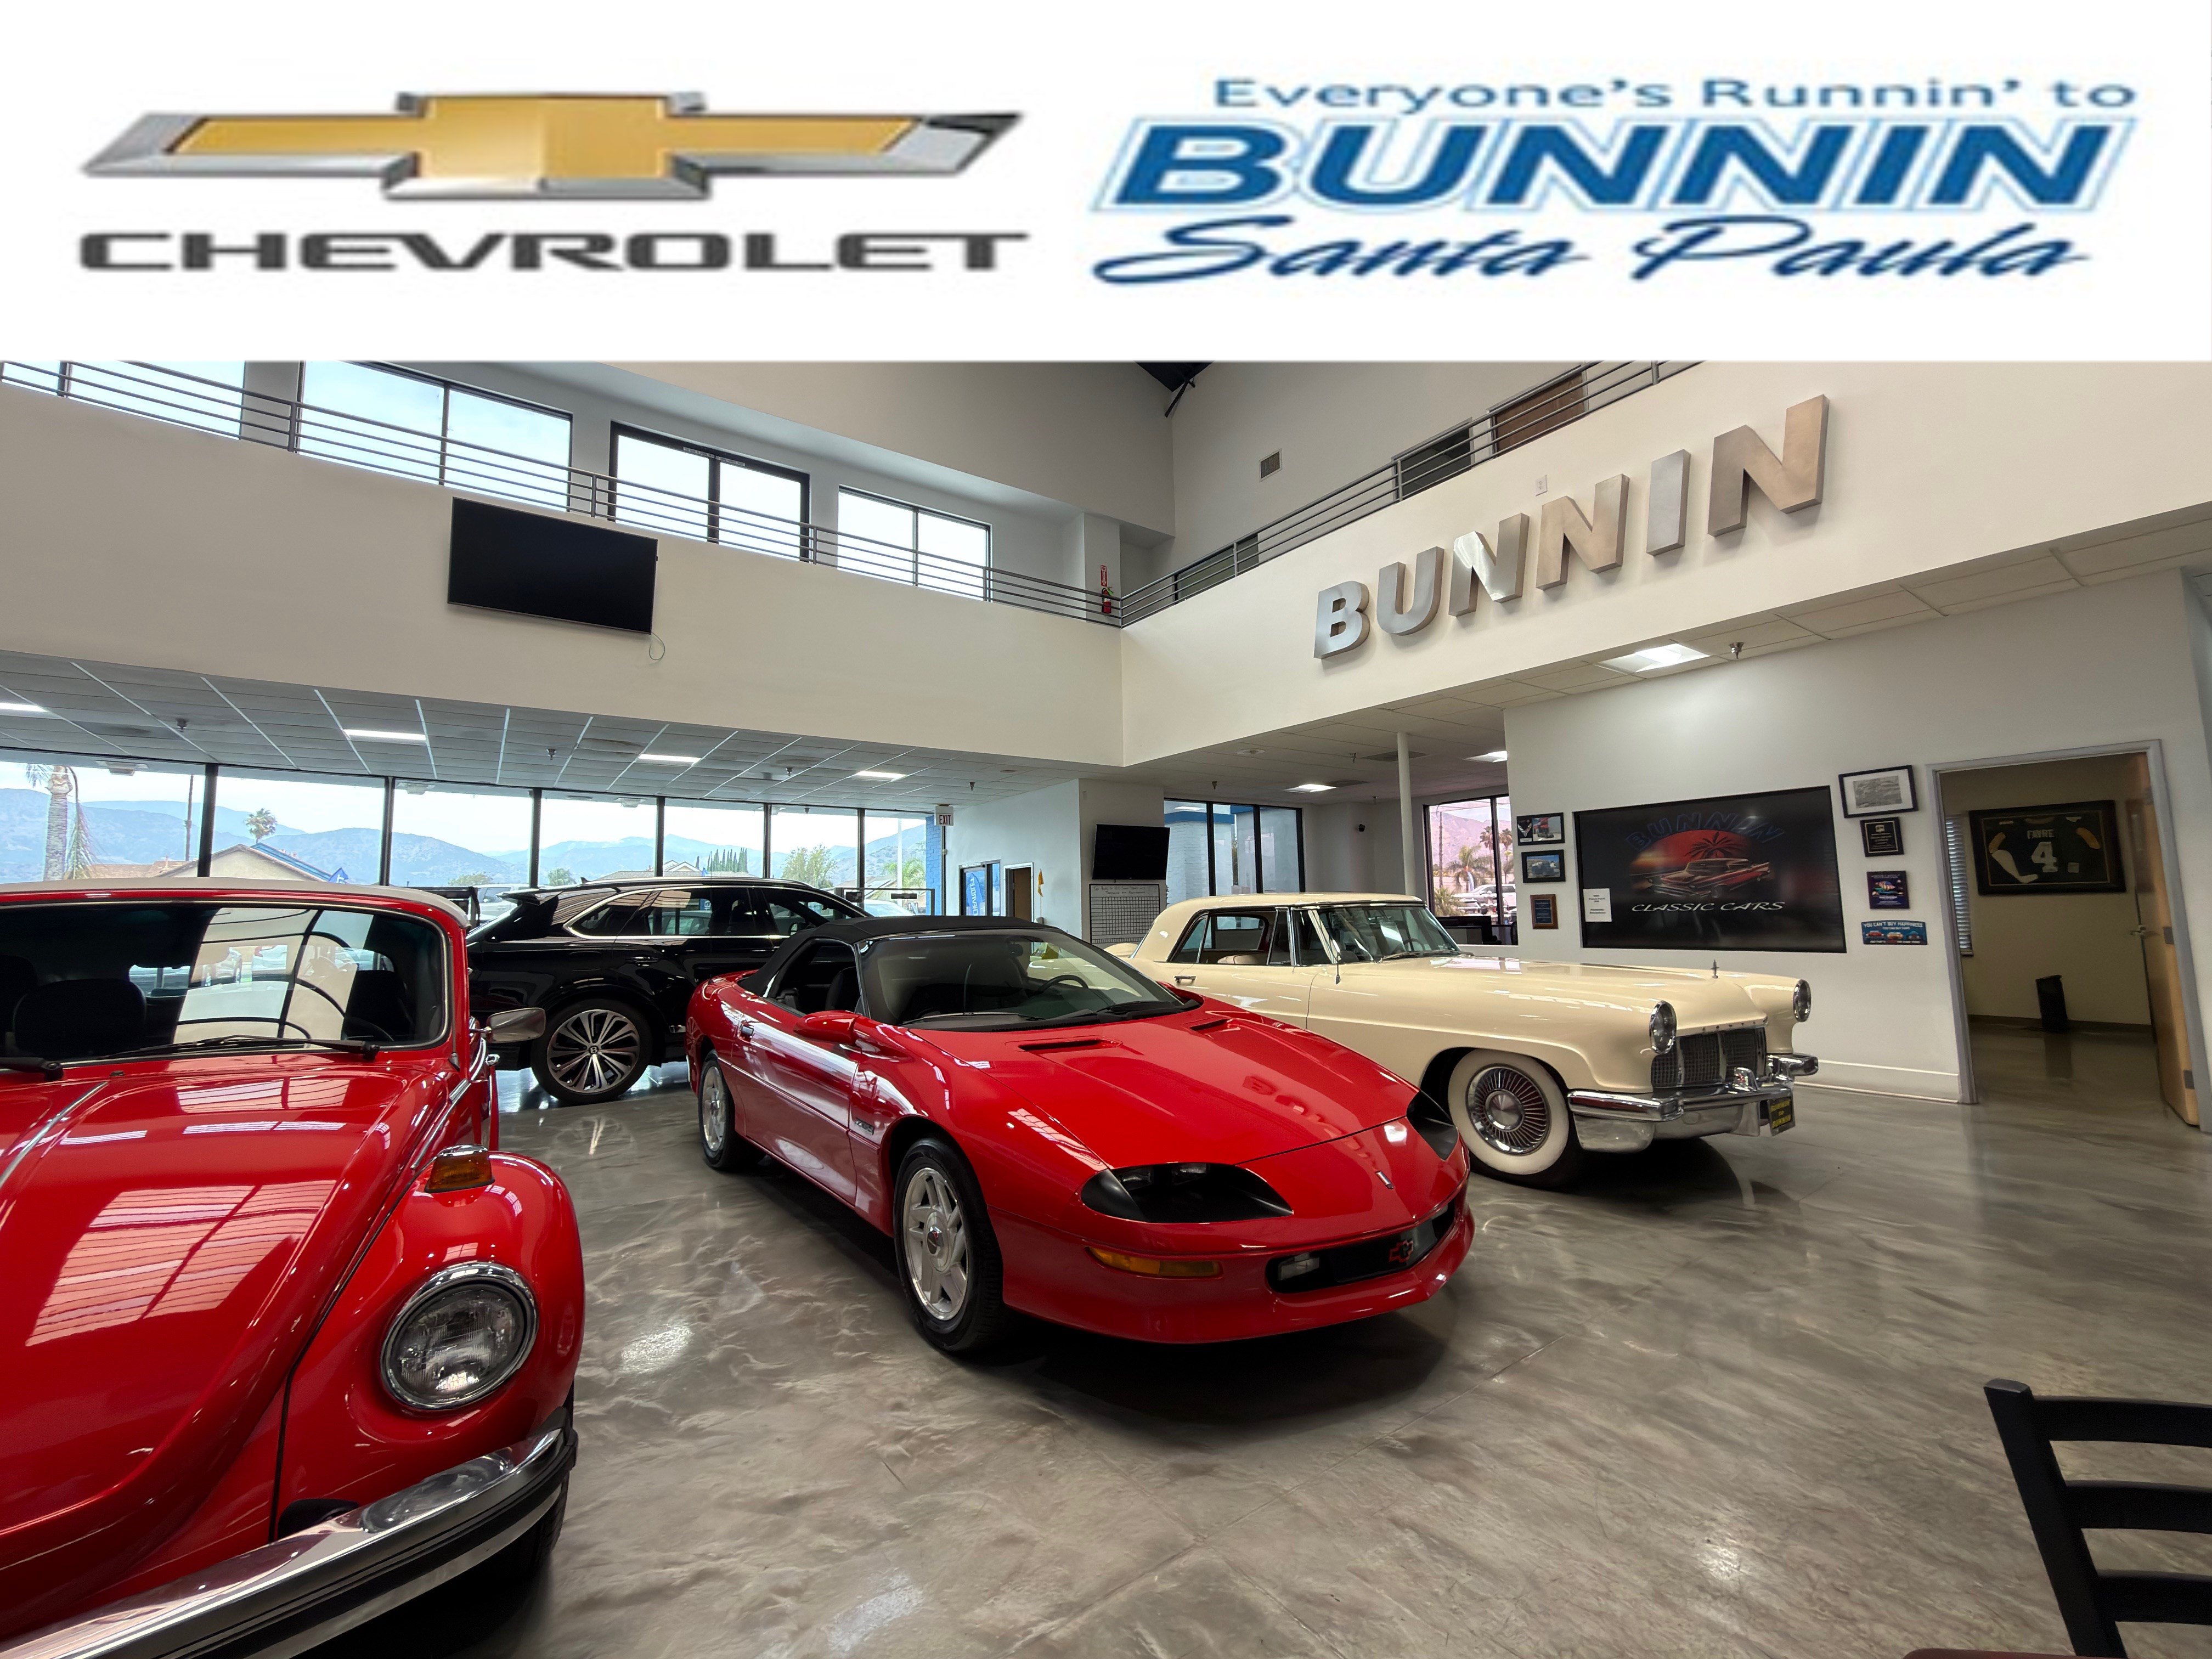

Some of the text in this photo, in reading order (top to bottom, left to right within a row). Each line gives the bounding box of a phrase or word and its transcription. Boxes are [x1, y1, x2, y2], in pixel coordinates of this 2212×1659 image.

[1314, 394, 1829, 659] BUNNIN
[939, 815, 951, 825] EXIT
[2031, 841, 2058, 873] 4
[1632, 901, 1785, 912] CLASSIC CARS
